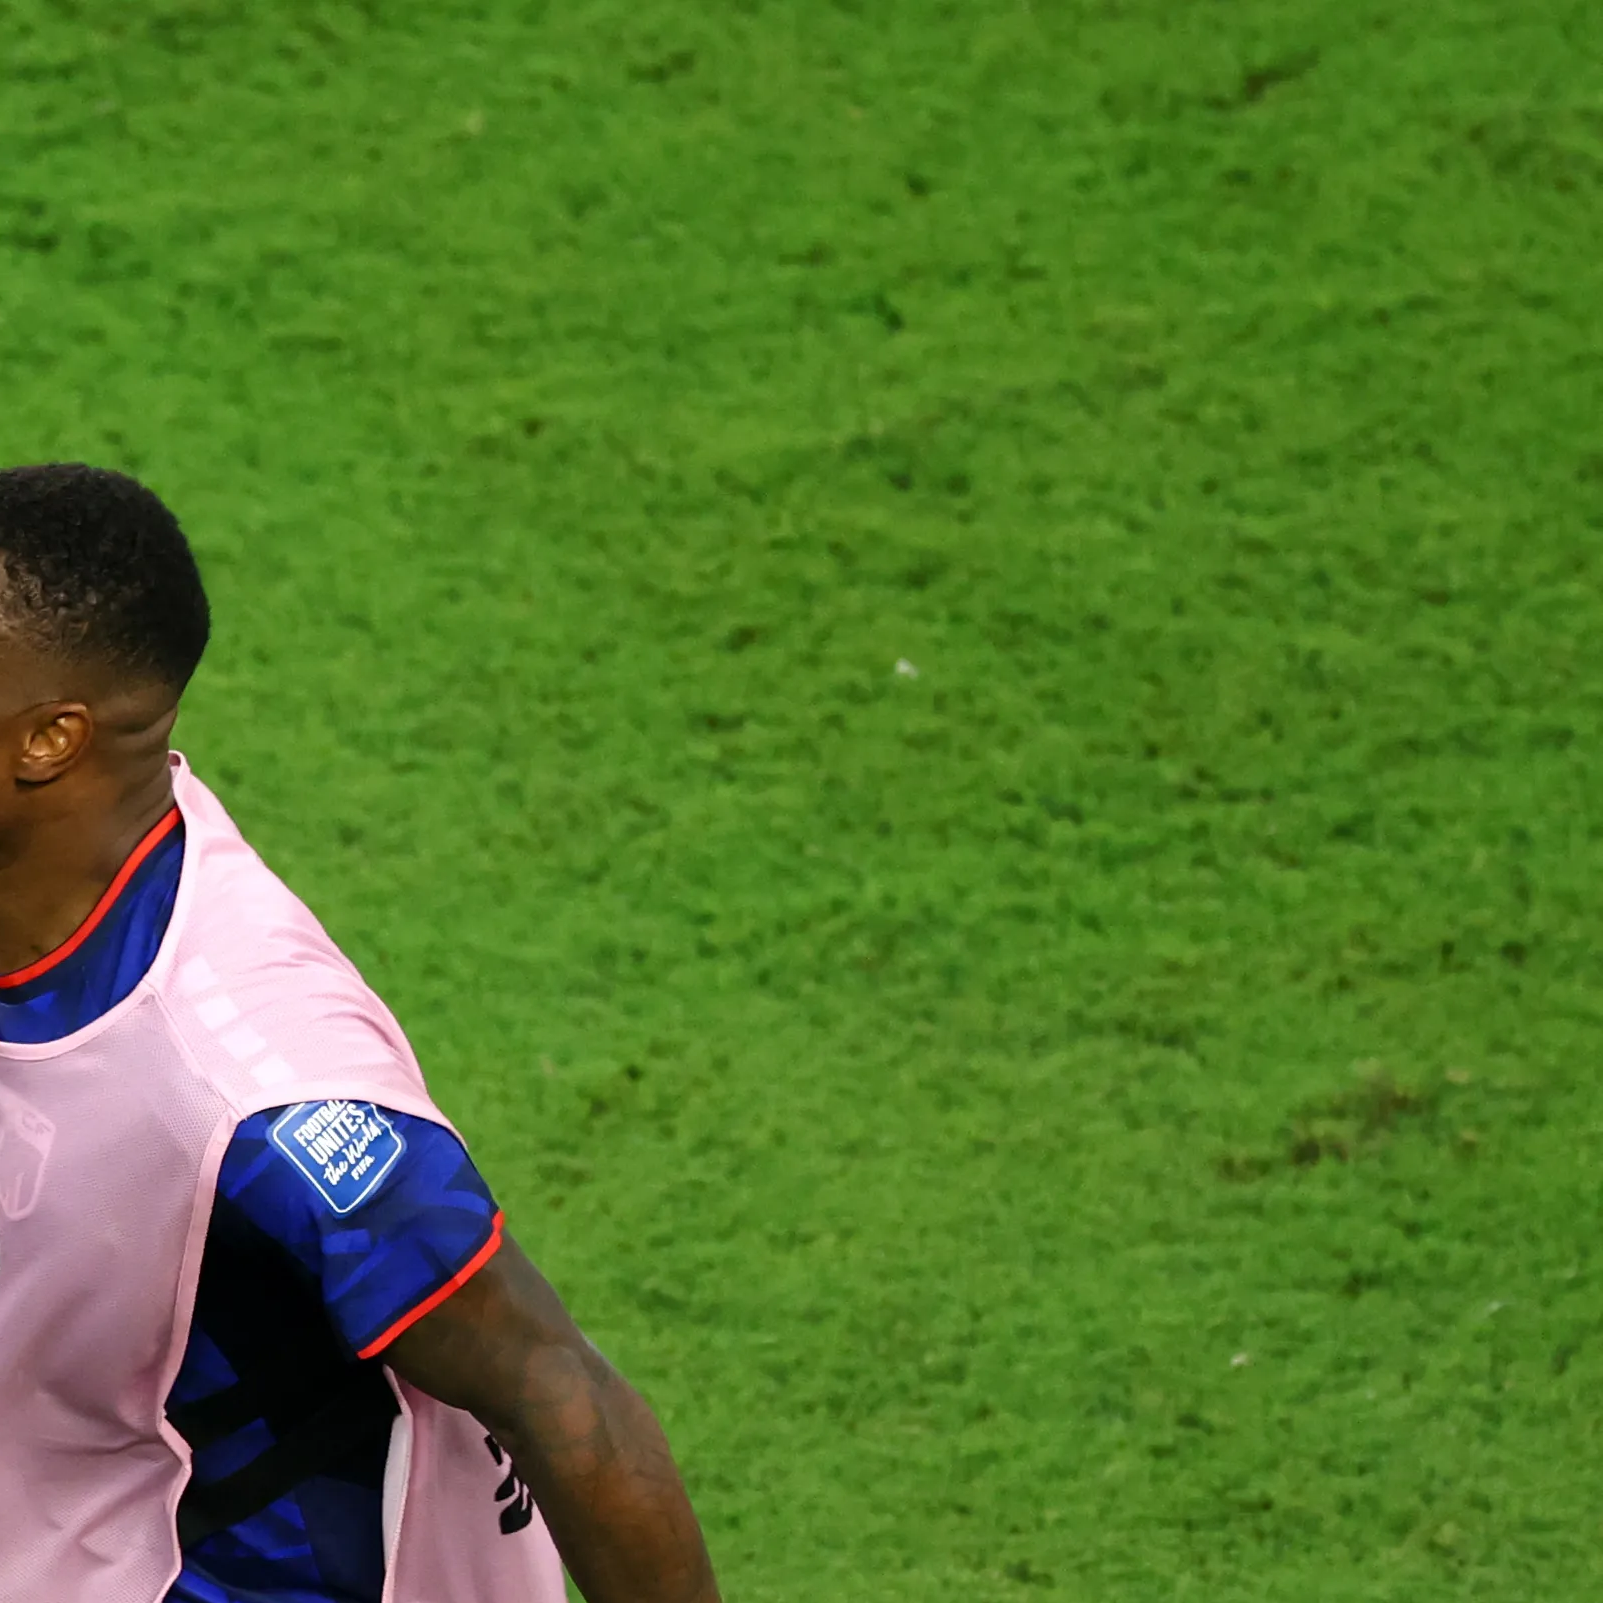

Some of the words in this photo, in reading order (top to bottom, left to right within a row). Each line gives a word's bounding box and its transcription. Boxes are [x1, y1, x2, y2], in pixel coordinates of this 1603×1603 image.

[293, 1099, 348, 1147] FOOTBAL
[306, 1103, 366, 1165] UNITES
[323, 1161, 349, 1186] the
[350, 1155, 375, 1181] FIFA
